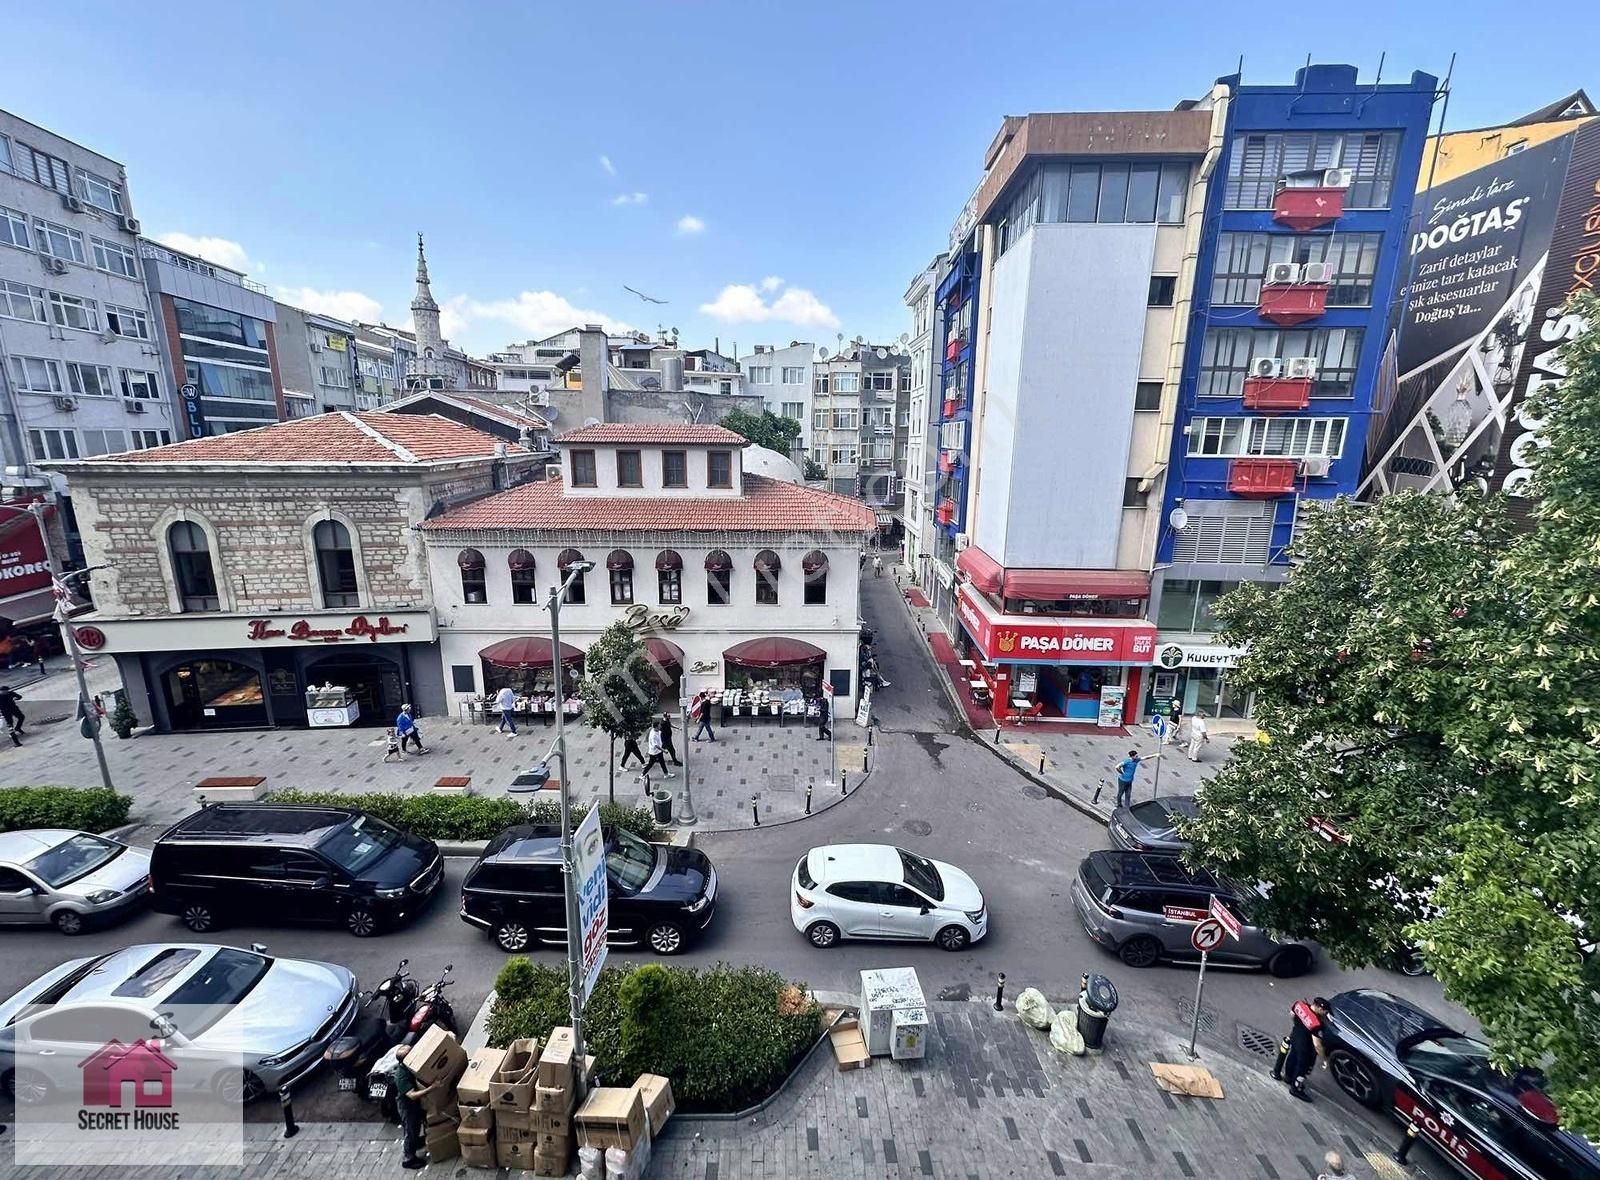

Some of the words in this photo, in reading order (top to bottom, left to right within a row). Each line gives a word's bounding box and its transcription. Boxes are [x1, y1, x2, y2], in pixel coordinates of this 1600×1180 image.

[1486, 177, 1514, 198] tarz
[1410, 199, 1524, 255] DOĞTAŞ
[1419, 257, 1449, 276] Zarif
[1449, 245, 1502, 268] detaylar
[1441, 273, 1465, 286] tarz
[1467, 256, 1519, 280] katacak
[1427, 281, 1499, 308] aksesuarlar
[1021, 636, 1060, 653] PAŞA
[1061, 634, 1113, 651] DÖNER
[582, 879, 605, 929] vidi
[1168, 908, 1197, 917] İSTANBUL
[584, 907, 606, 961] göz
